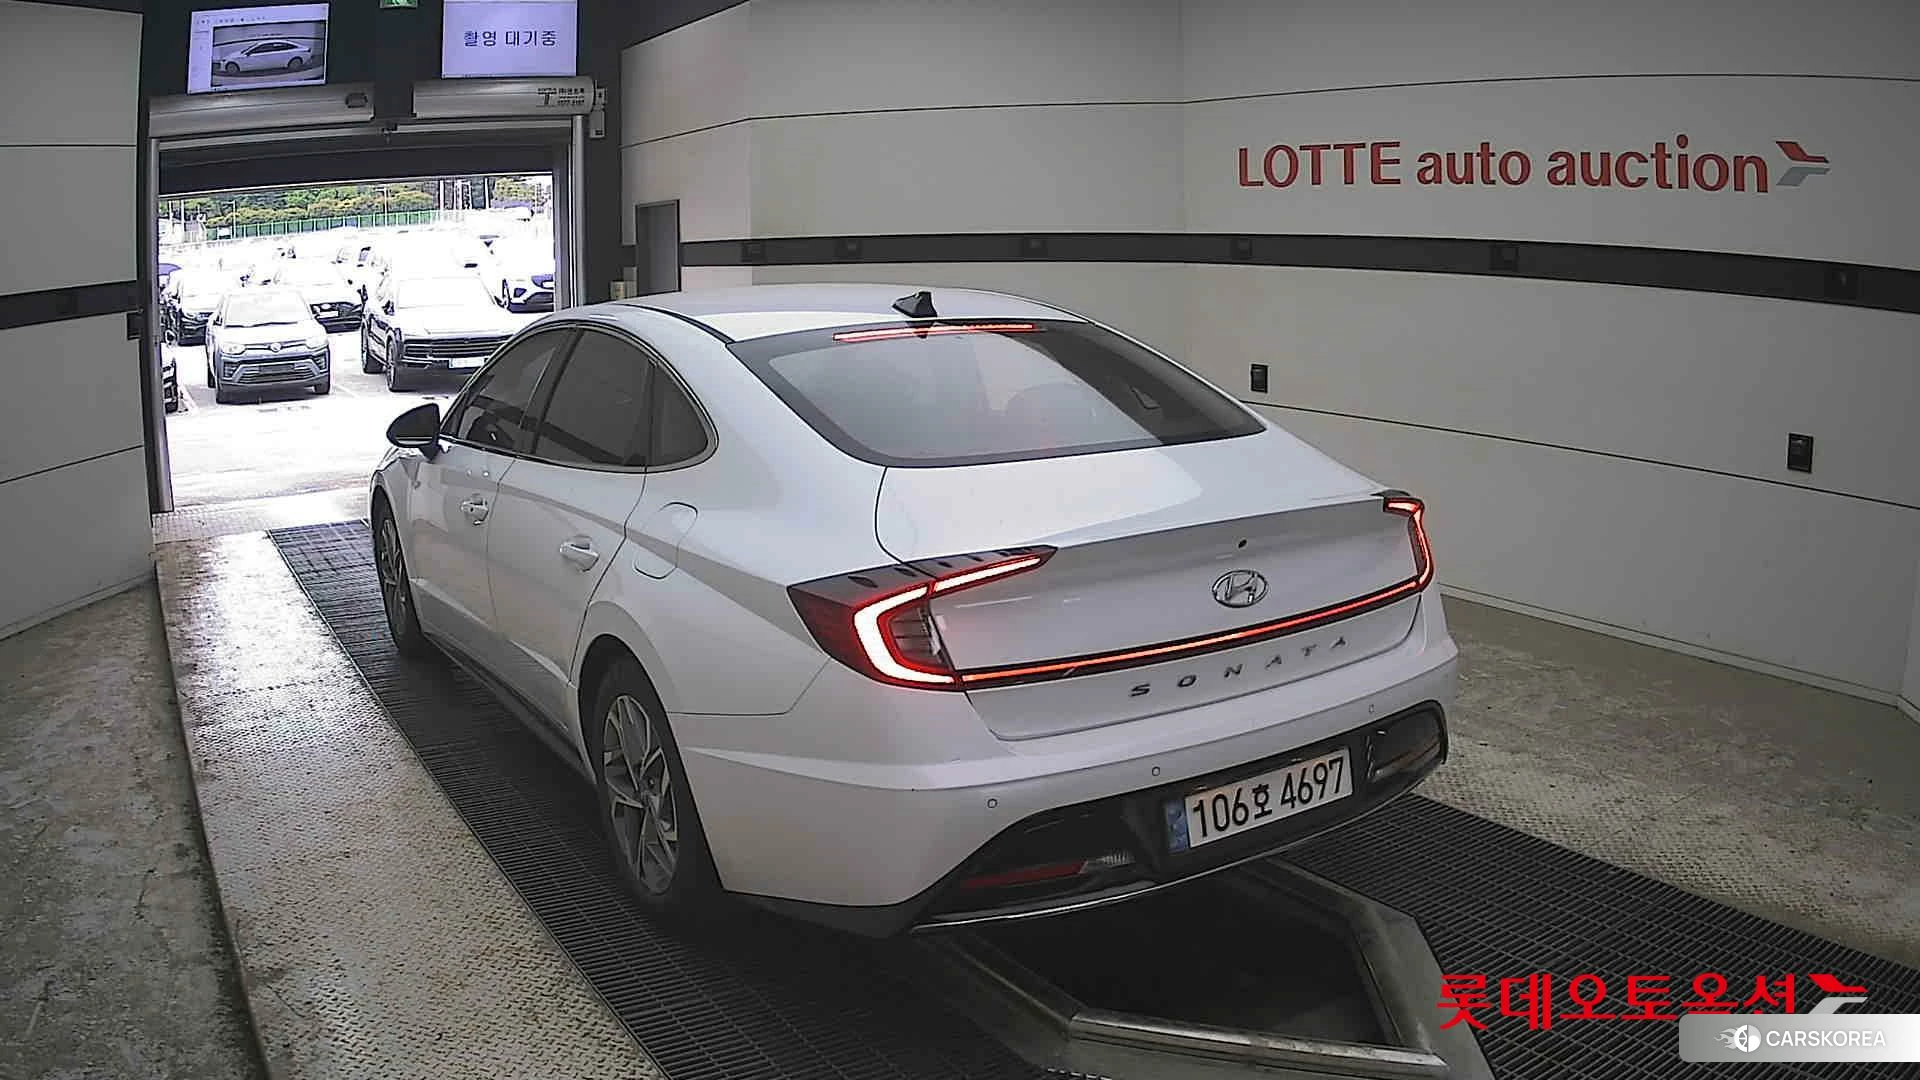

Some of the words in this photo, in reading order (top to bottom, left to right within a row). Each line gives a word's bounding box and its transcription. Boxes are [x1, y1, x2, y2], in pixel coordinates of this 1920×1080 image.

[463, 30, 497, 47] 촬영
[505, 30, 557, 47] 대기중
[1238, 140, 1401, 188] LOTTE
[1416, 141, 1532, 186] auto
[1547, 134, 1769, 193] auction
[1130, 636, 1347, 697] SONATA
[1192, 783, 1273, 838] 106호
[1280, 756, 1344, 809] 4697
